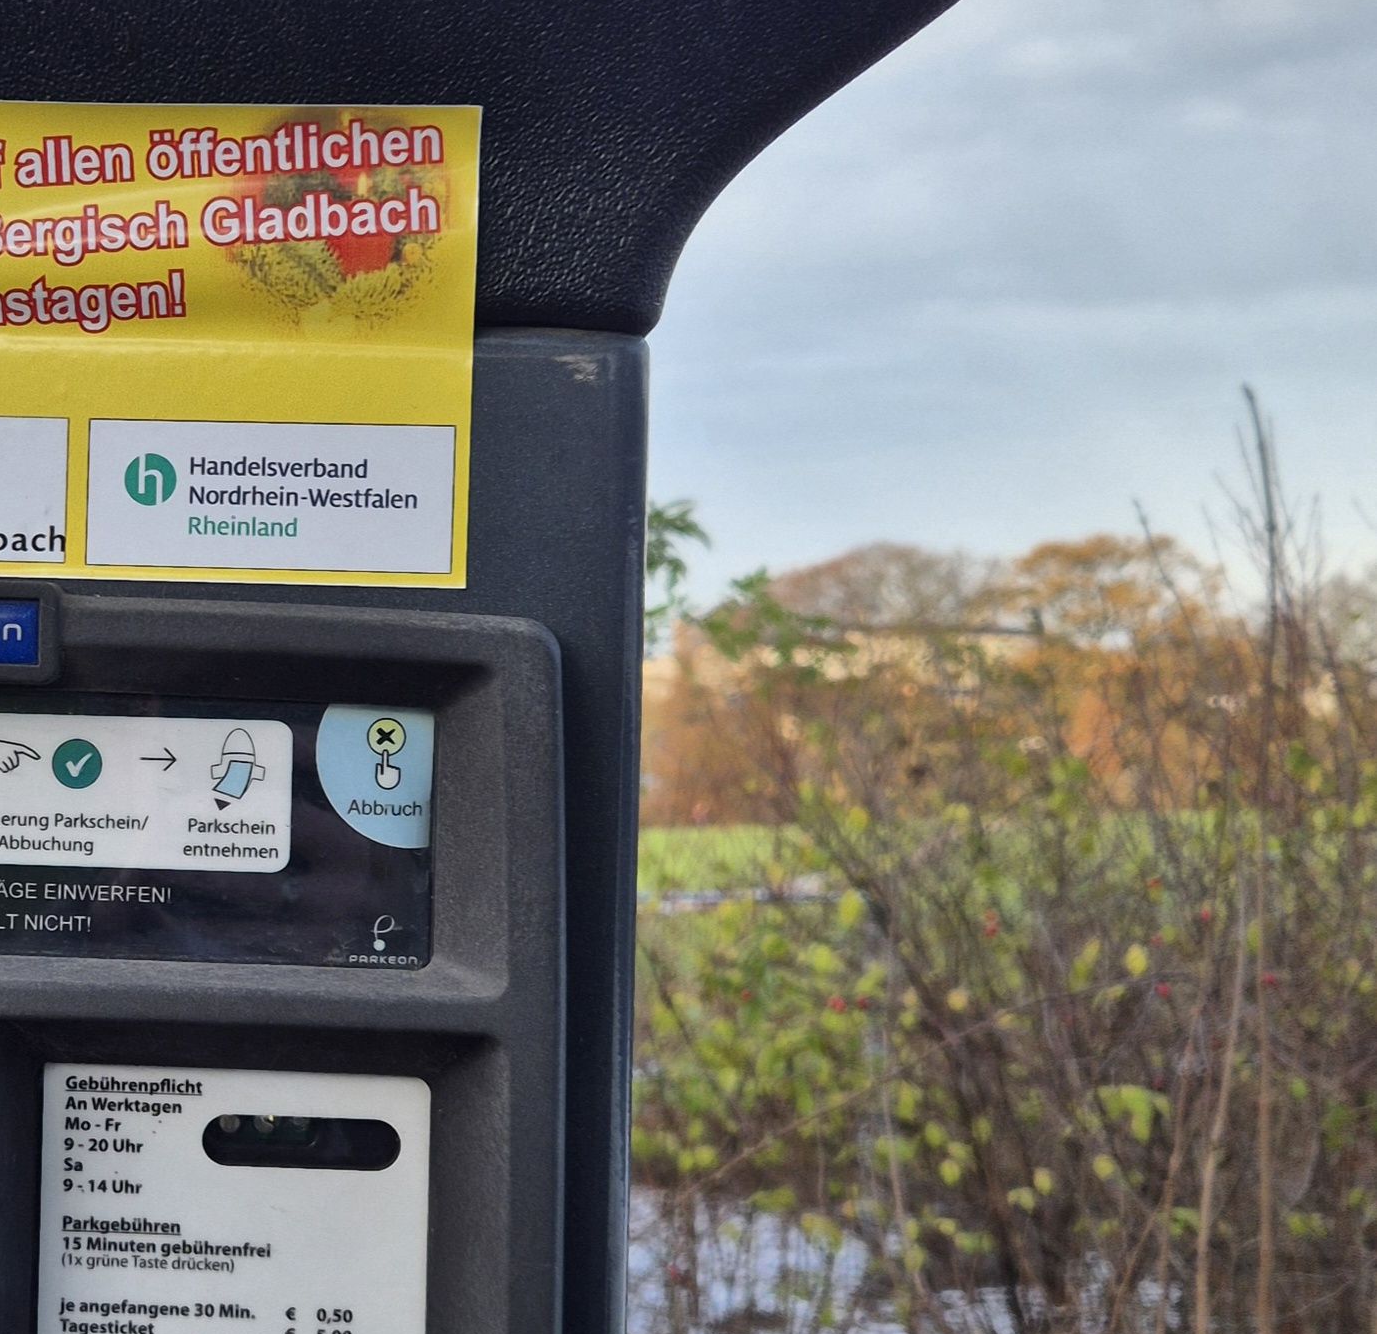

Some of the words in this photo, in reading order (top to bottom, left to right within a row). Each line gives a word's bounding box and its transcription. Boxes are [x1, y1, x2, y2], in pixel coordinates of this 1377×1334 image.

[15, 135, 135, 188] allen
[147, 119, 443, 180] öffentlichen
[200, 187, 440, 247] Gladbach
[189, 456, 368, 479] Handelsverband
[189, 485, 418, 510] Nordrhein-Westfalen
[188, 516, 298, 538] Rheinland
[347, 799, 423, 817] Abbruch
[54, 811, 149, 831] Parkschein/
[187, 817, 276, 836] Parkschein
[183, 842, 279, 859] entnehmen
[44, 883, 172, 903] EINWERFEN!
[24, 913, 91, 933] NICHT!
[349, 953, 419, 966] PARKEON
[65, 1075, 203, 1095] Gebührenpflicht
[65, 1096, 88, 1111] An
[91, 1097, 182, 1116] Werktagen
[65, 1117, 91, 1131] Mo
[105, 1118, 122, 1132] Fr
[64, 1137, 75, 1151] 9
[88, 1138, 109, 1152] 20
[112, 1138, 144, 1153] Uhr
[64, 1157, 83, 1172] Sa
[63, 1178, 74, 1192] 9
[88, 1179, 108, 1193] 14
[112, 1179, 143, 1194] Uhr
[61, 1215, 181, 1235] Parkgebühren
[62, 1236, 82, 1250] 15
[86, 1237, 156, 1253] Minuten
[160, 1240, 271, 1258] gebührenfrei
[61, 1253, 82, 1267] (1x
[86, 1254, 128, 1269] grüne
[132, 1255, 168, 1269] Taste
[171, 1256, 235, 1273] drücken)
[59, 1297, 75, 1315] je
[79, 1300, 190, 1318] angefangene
[194, 1303, 214, 1317] 30
[219, 1304, 255, 1319] Min.
[285, 1307, 296, 1321] €
[316, 1308, 353, 1324] 0,50
